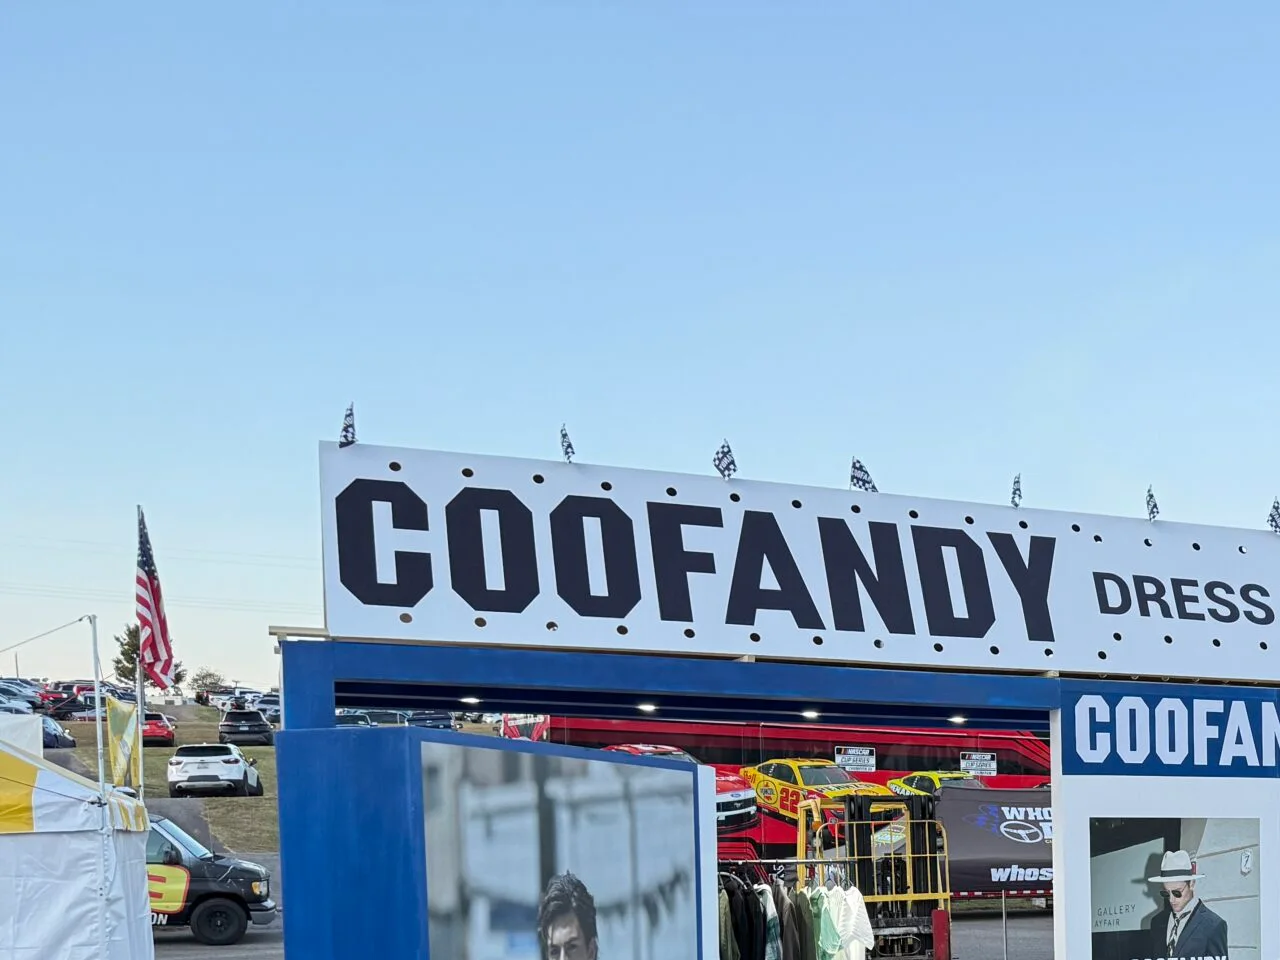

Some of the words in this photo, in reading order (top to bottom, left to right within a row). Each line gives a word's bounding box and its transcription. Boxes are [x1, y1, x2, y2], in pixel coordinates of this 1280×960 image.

[335, 478, 1056, 643] COOFANDY
[1092, 570, 1275, 626] DRESS
[779, 787, 800, 815] 22
[1097, 904, 1136, 917] GALLERY
